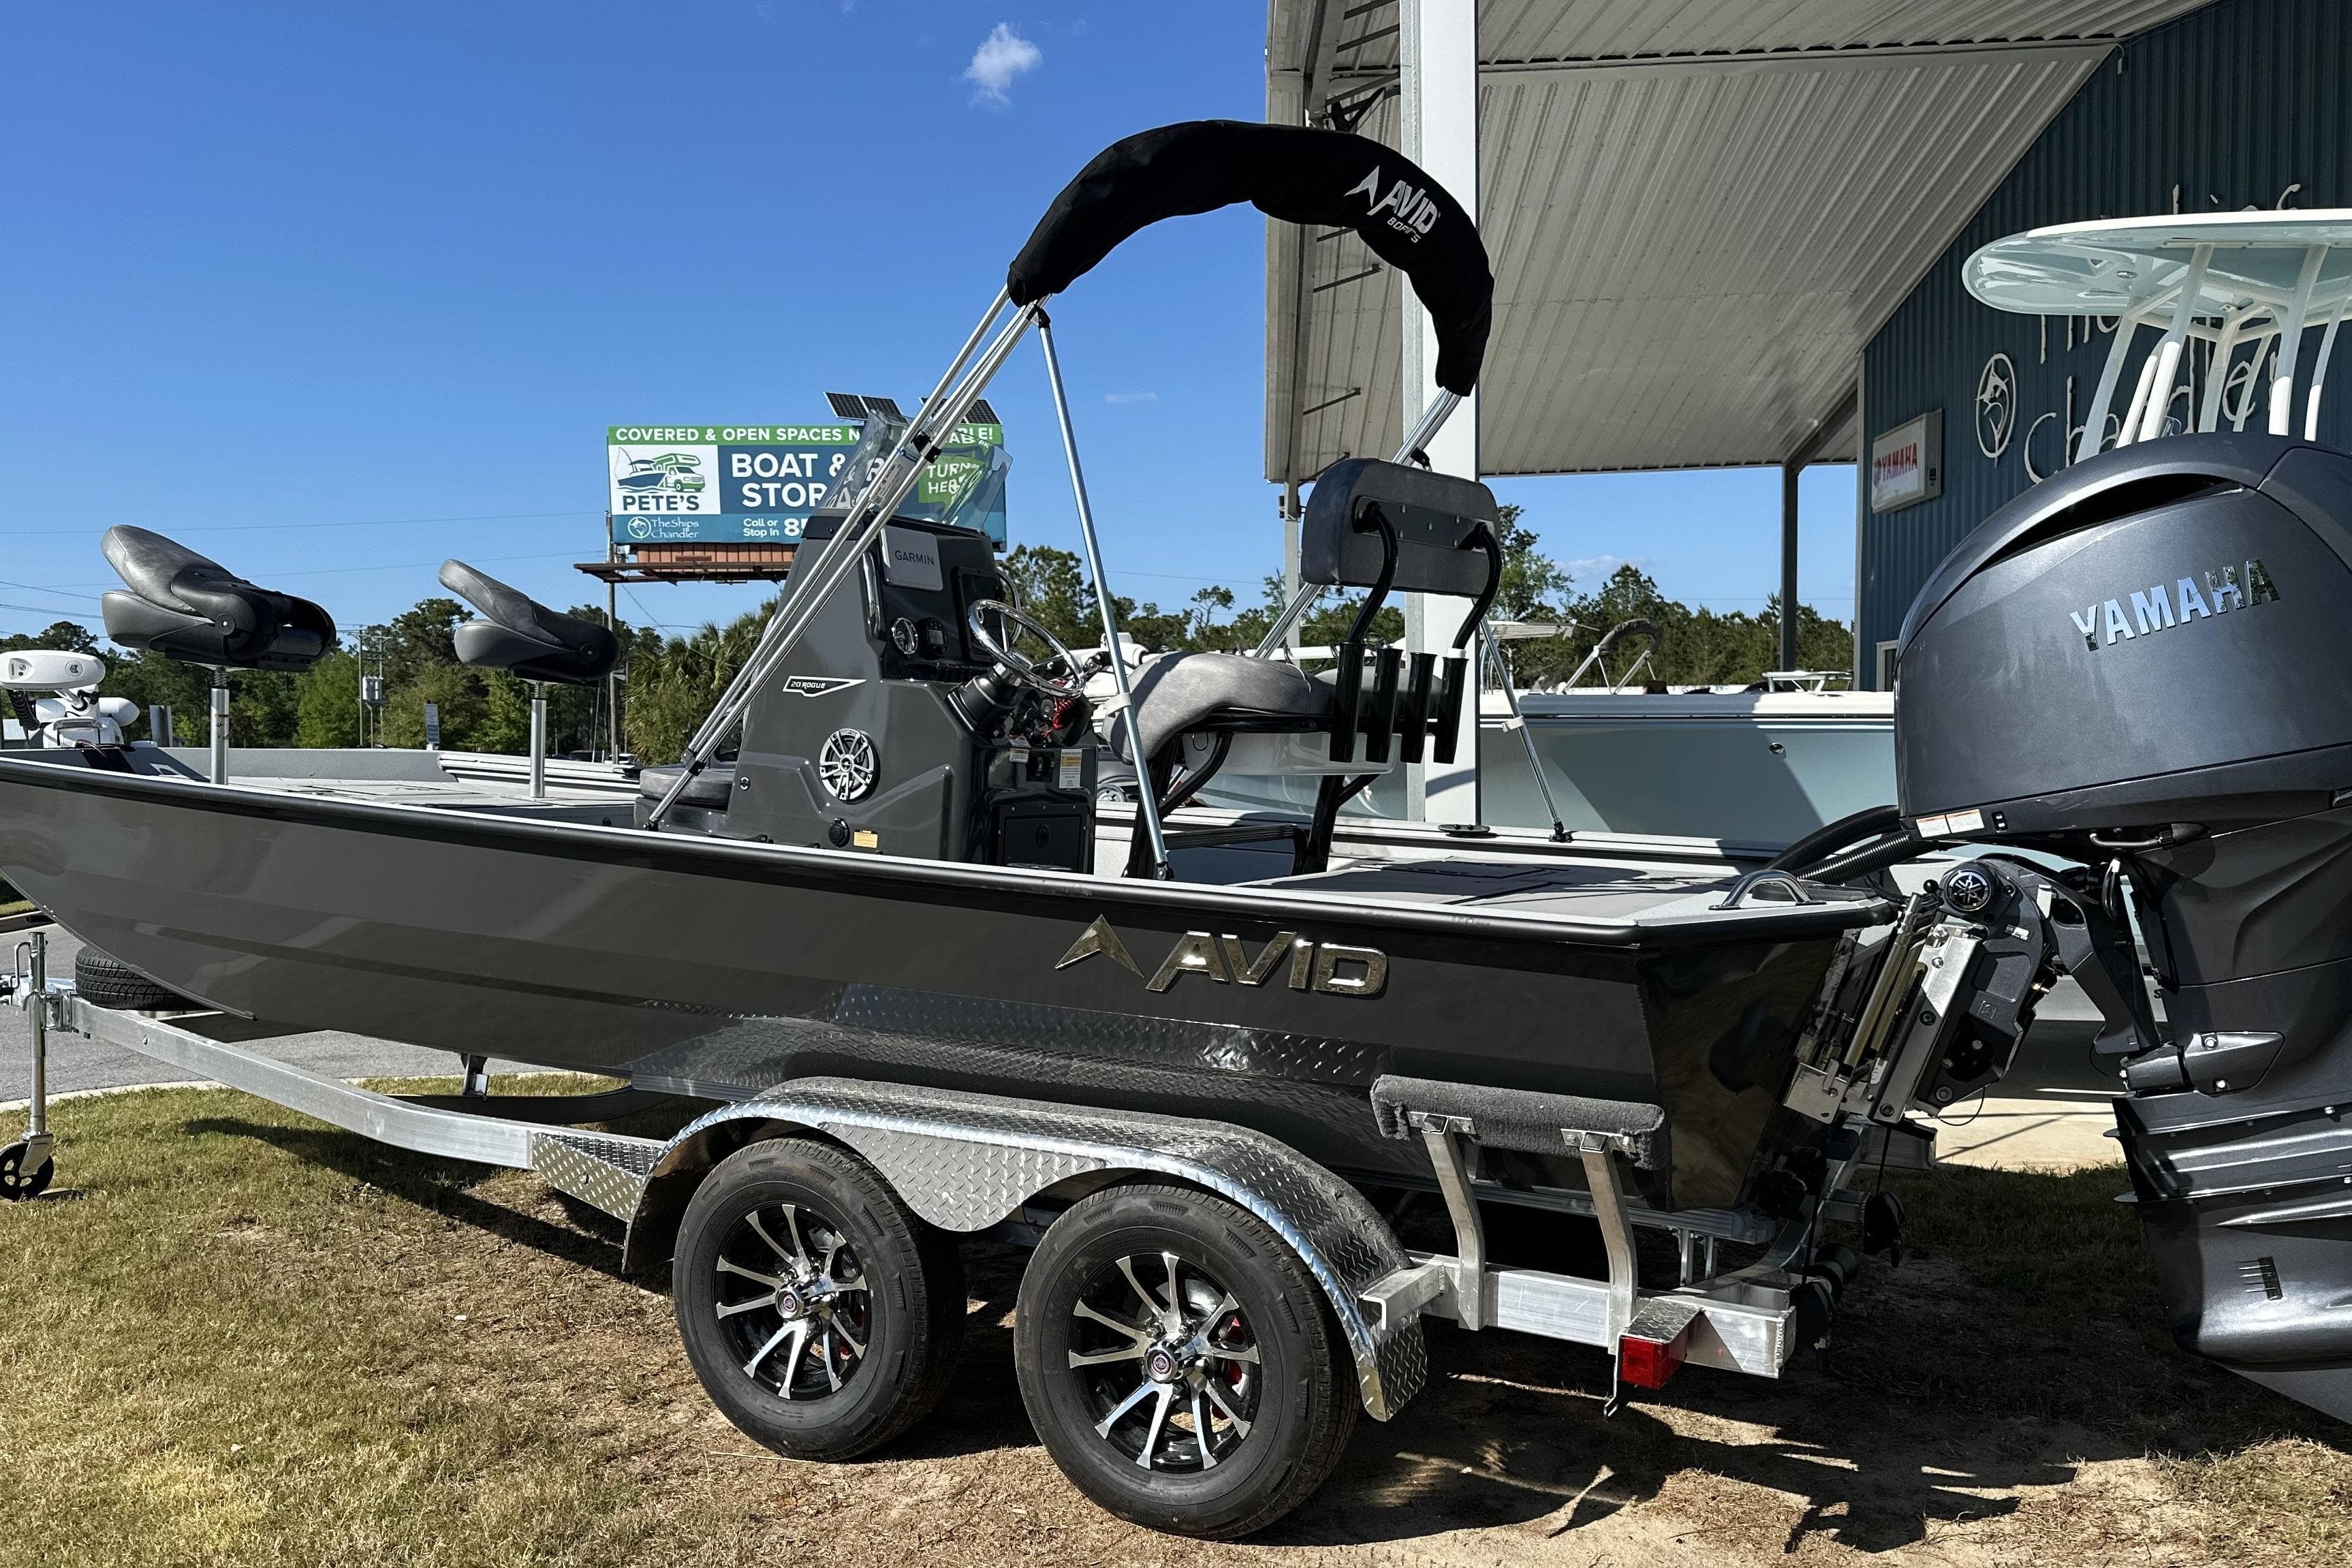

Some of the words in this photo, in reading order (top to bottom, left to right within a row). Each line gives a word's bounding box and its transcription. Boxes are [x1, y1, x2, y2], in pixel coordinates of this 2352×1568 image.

[1366, 179, 1439, 234] AVID
[616, 428, 700, 441] COVERED
[705, 428, 717, 441] &
[723, 428, 770, 441] OPEN
[777, 427, 843, 441] SPACES
[731, 453, 819, 477] BOAT
[829, 453, 846, 477] &
[1881, 443, 1917, 482] YAMAHA
[623, 495, 700, 511] PETE'S
[743, 518, 765, 527] Call
[650, 528, 699, 538] Chandler
[743, 528, 767, 538] Stop
[770, 528, 779, 536] In
[894, 550, 935, 566] GARMIN
[2069, 559, 2280, 651] YAMAHA
[802, 681, 826, 690] ROGUE
[1146, 930, 1388, 994] AVID
